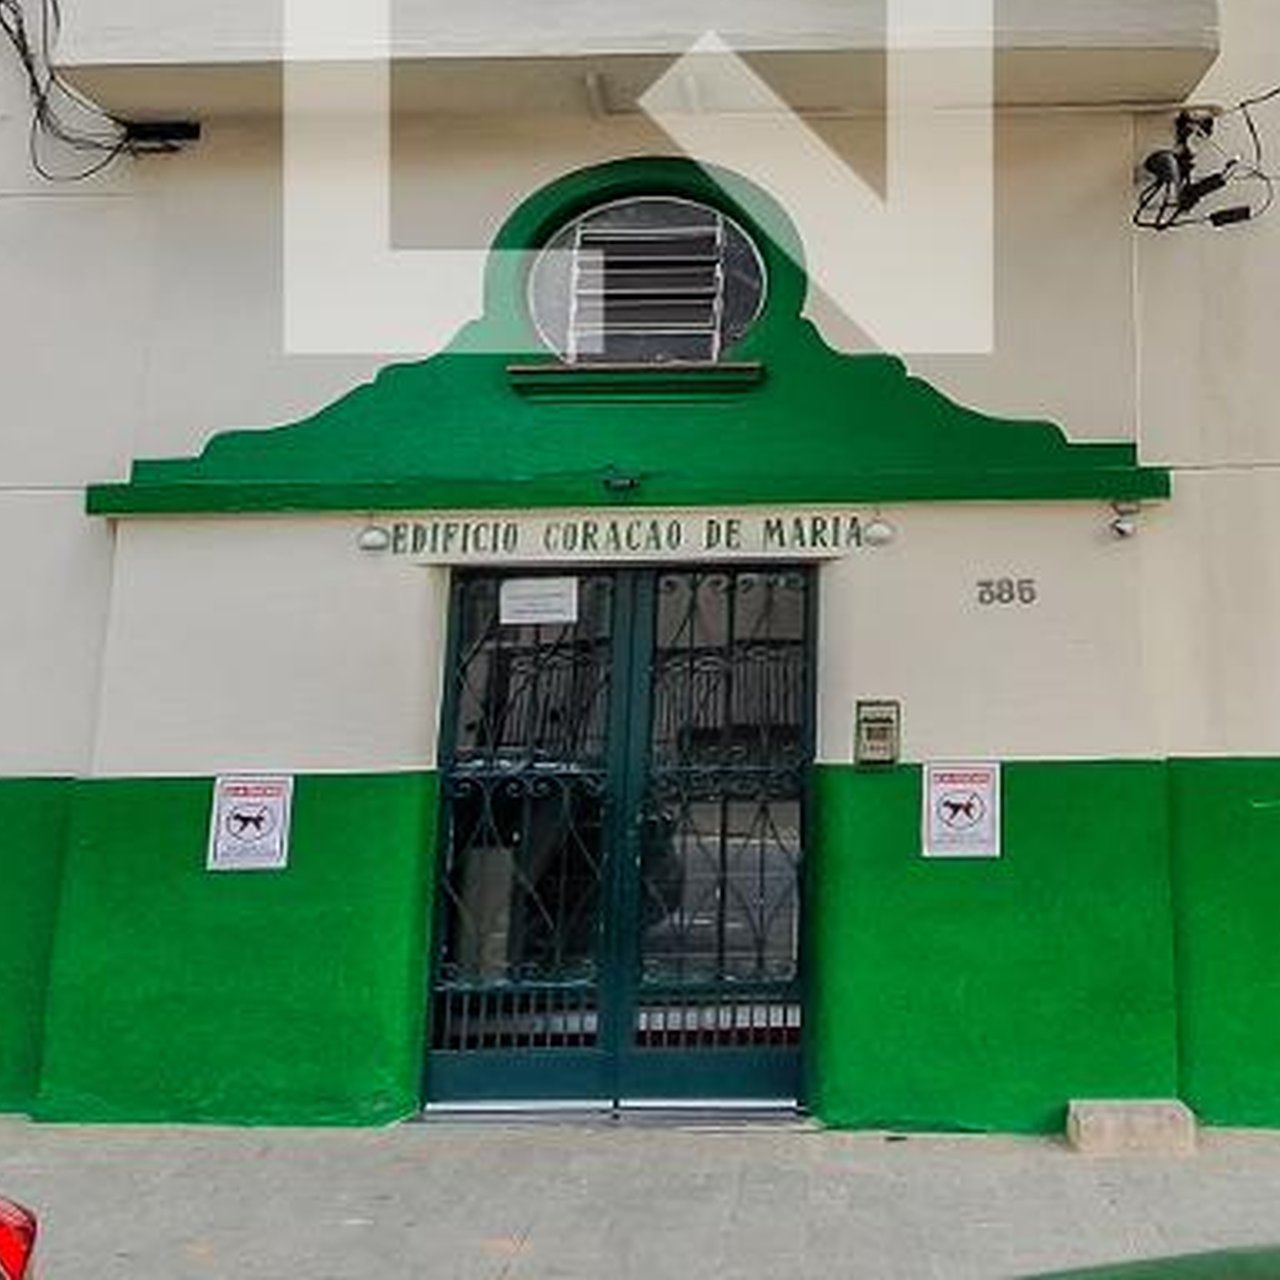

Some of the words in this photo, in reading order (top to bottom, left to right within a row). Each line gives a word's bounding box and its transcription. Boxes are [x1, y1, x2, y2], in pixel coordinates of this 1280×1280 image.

[392, 521, 519, 555] EDIFICIO
[705, 518, 742, 551] DE
[763, 516, 863, 550] MARIA
[976, 577, 1037, 605] 385
